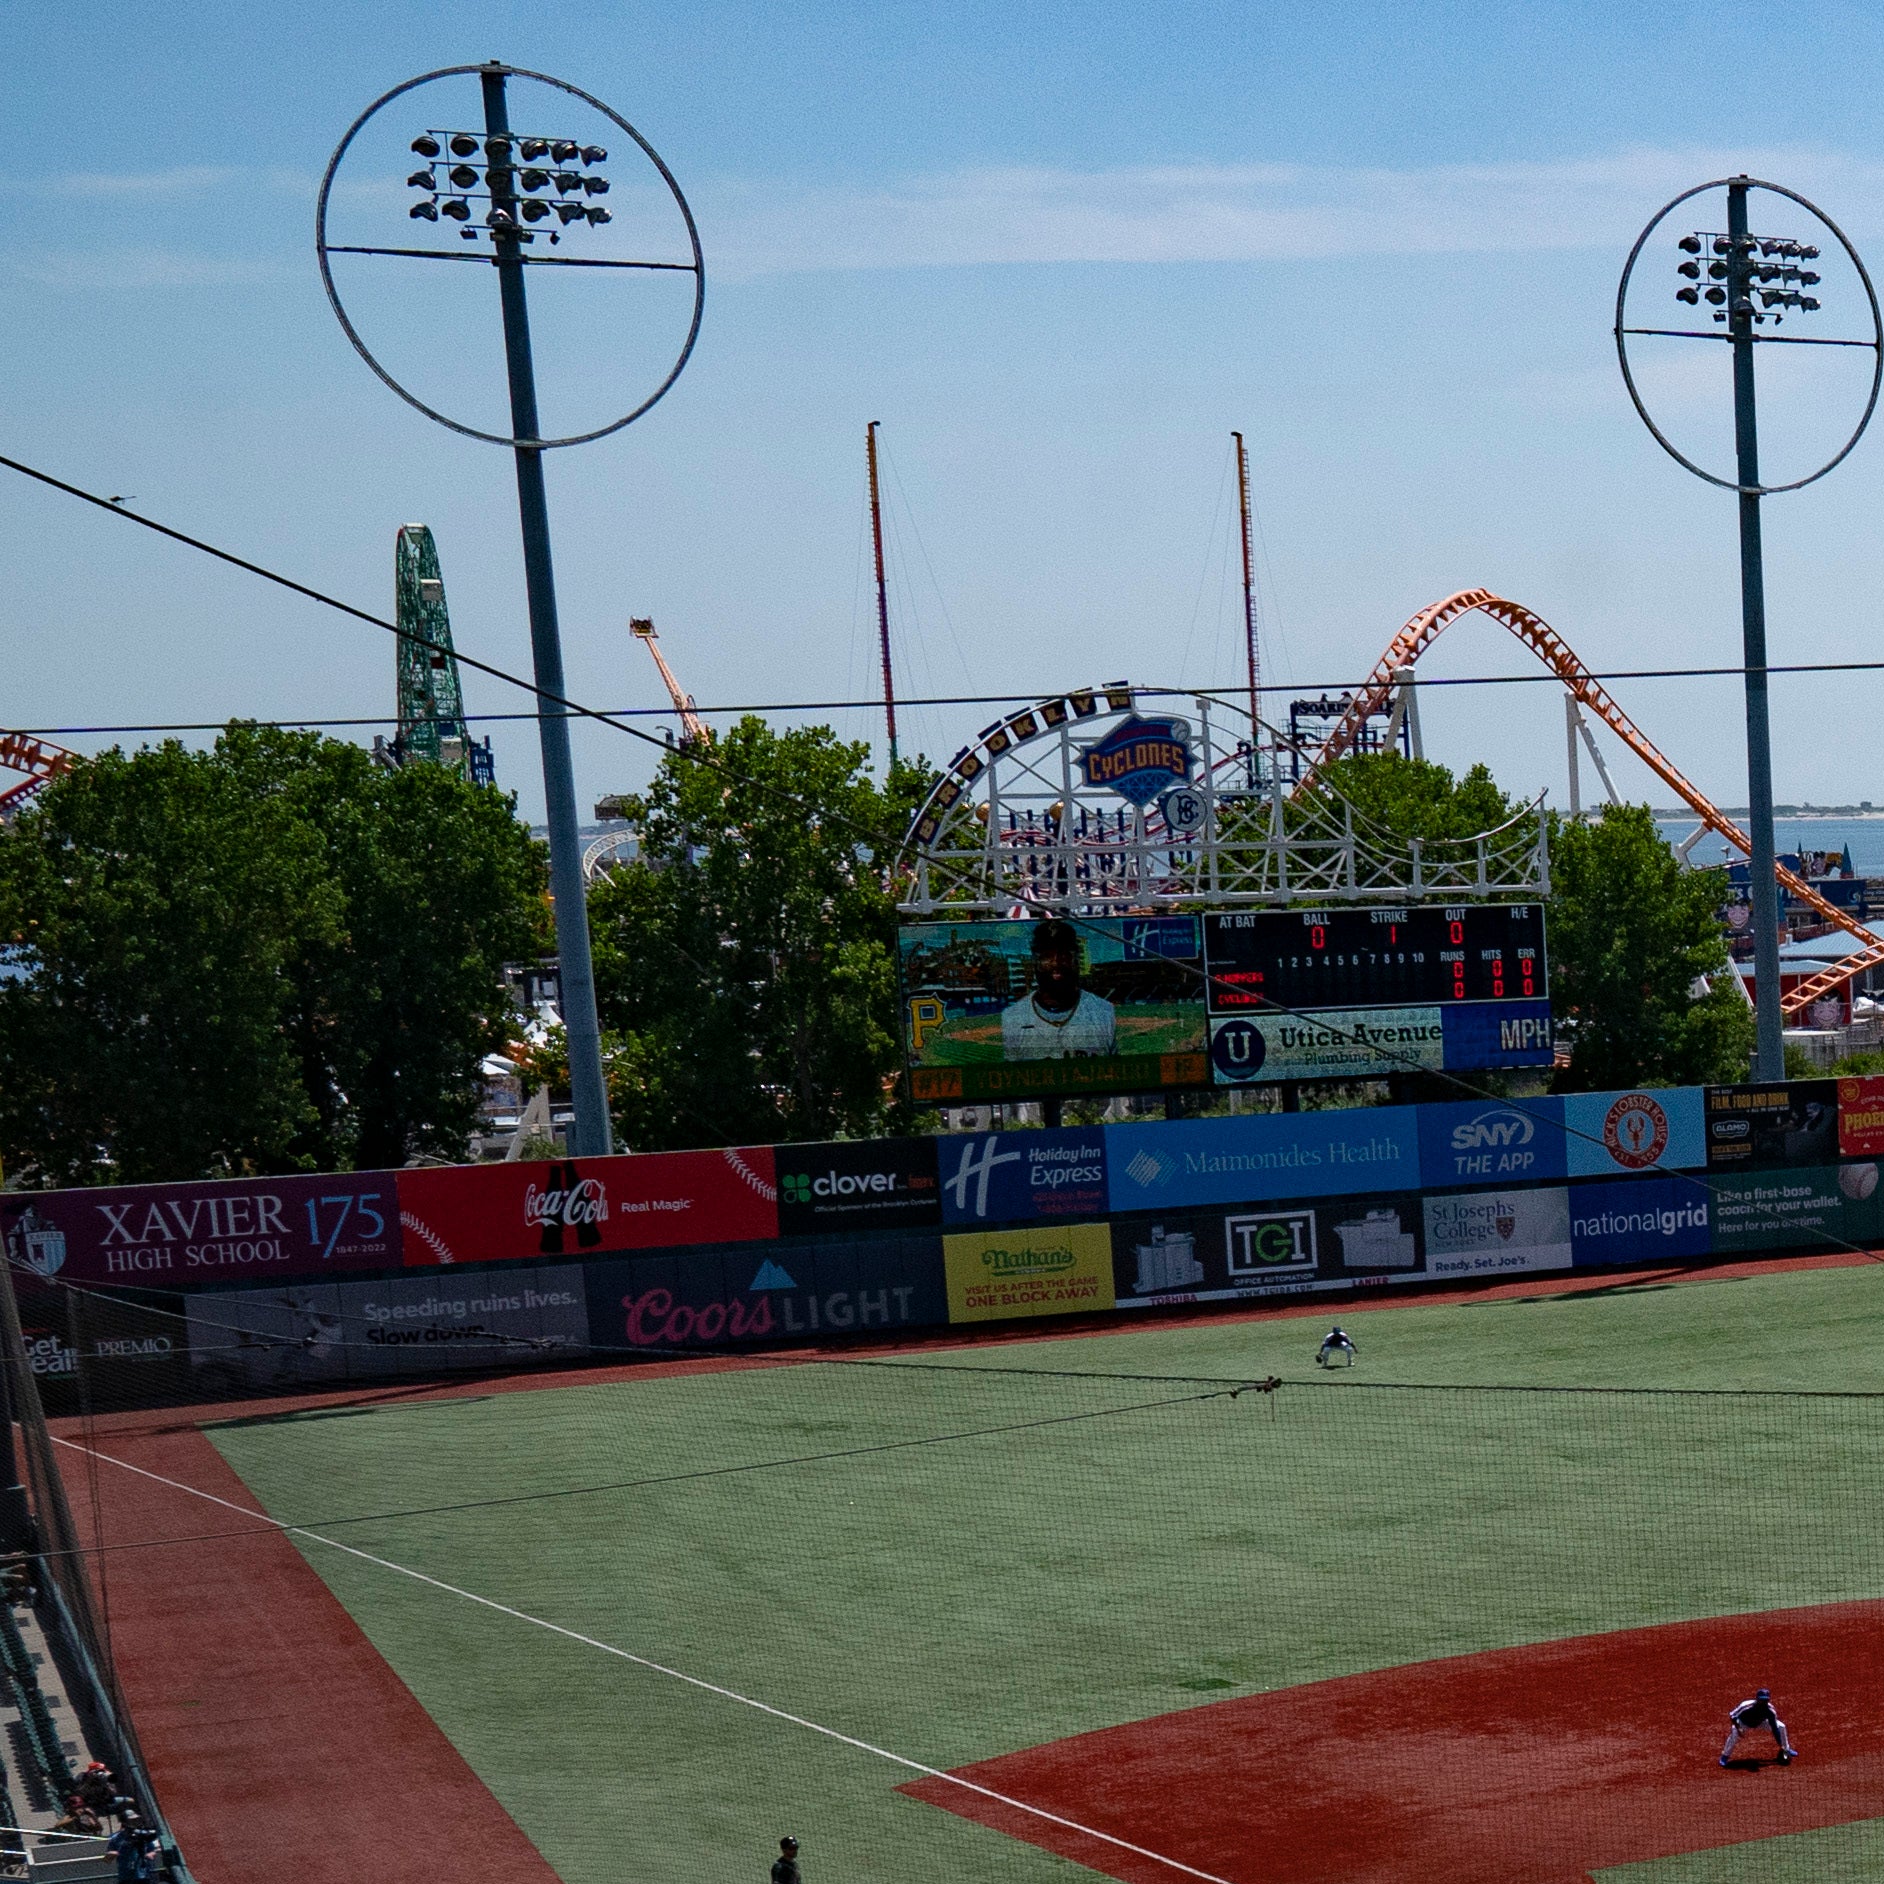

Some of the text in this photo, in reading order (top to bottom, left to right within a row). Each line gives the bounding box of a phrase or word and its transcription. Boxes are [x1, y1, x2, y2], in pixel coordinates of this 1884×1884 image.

[918, 693, 1130, 839] BROOKLYN
[1089, 741, 1185, 781] CYCLONES
[1220, 915, 1256, 928] AT BAT
[1303, 913, 1330, 926] BALL
[1370, 910, 1408, 924] STRIKE
[1445, 908, 1466, 921] OUT
[1511, 906, 1529, 919] H/E
[1311, 925, 1325, 950] 0
[1449, 921, 1464, 945] 0
[1440, 948, 1536, 962] RUNS HITS ERR
[1280, 1023, 1443, 1048] Utica Avenue
[1501, 1018, 1550, 1050] MPH
[1305, 1050, 1370, 1067] Plumbing
[1451, 1116, 1524, 1150] SNY
[1716, 1123, 1747, 1132] ALAMO
[1028, 1145, 1101, 1164] Holiday Inn
[1186, 1138, 1400, 1174] Maimonides Health
[1454, 1152, 1535, 1175] THE APP
[813, 1170, 897, 1196] clover
[1030, 1166, 1103, 1190] Express
[621, 1199, 690, 1213] Real Magic
[1433, 1204, 1447, 1220] St
[1717, 1203, 1753, 1217] coach
[1774, 1200, 1800, 1214] your
[1803, 1195, 1842, 1209] wallet.
[96, 1195, 291, 1246] XAVIER
[305, 1193, 384, 1258] 175
[1433, 1217, 1496, 1241] College
[1574, 1202, 1708, 1237] nationalgrid
[107, 1241, 290, 1272] HIGH SCHOOL
[981, 1246, 1077, 1271] Nathan's
[1435, 1259, 1470, 1273] Ready.
[1475, 1257, 1496, 1269] Set.
[965, 1276, 1098, 1295] VISIT US AFTER THE GAME
[1233, 1272, 1315, 1286] OFFICE AUTOMATION
[1352, 1276, 1388, 1287] LANIER
[365, 1290, 578, 1322] Speeding ruins lives.
[966, 1286, 1098, 1308] ONE BLOCK AWAY
[622, 1286, 914, 1345] Coors LIGHT
[367, 1322, 486, 1347] Slow down
[96, 1337, 171, 1357] PREMIO
